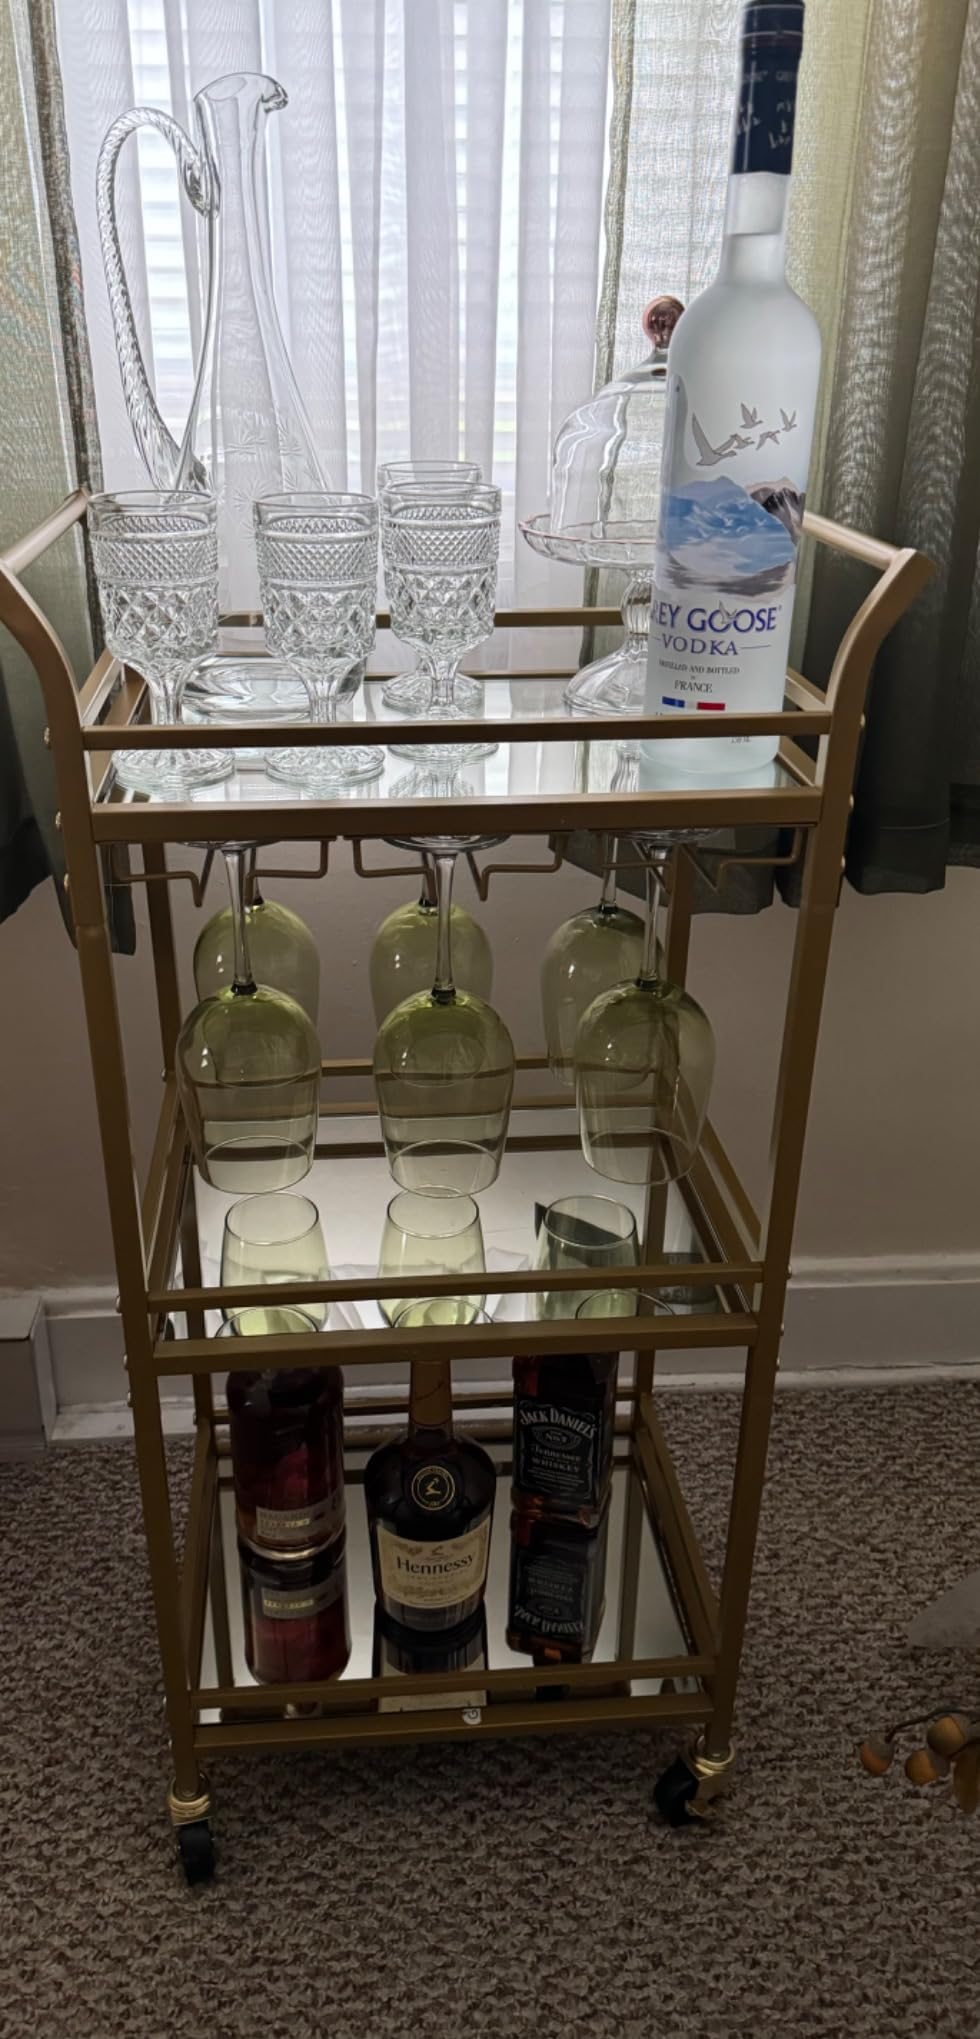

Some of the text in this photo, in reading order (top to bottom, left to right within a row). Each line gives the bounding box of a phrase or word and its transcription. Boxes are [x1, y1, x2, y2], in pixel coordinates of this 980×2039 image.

[687, 605, 777, 632] GOOSE
[661, 633, 738, 656] VODKA
[690, 665, 704, 674] AND
[674, 680, 713, 693] FRANCE
[519, 1407, 598, 1440] JACK DANIEL'S
[396, 1554, 472, 1575] Hennessy
